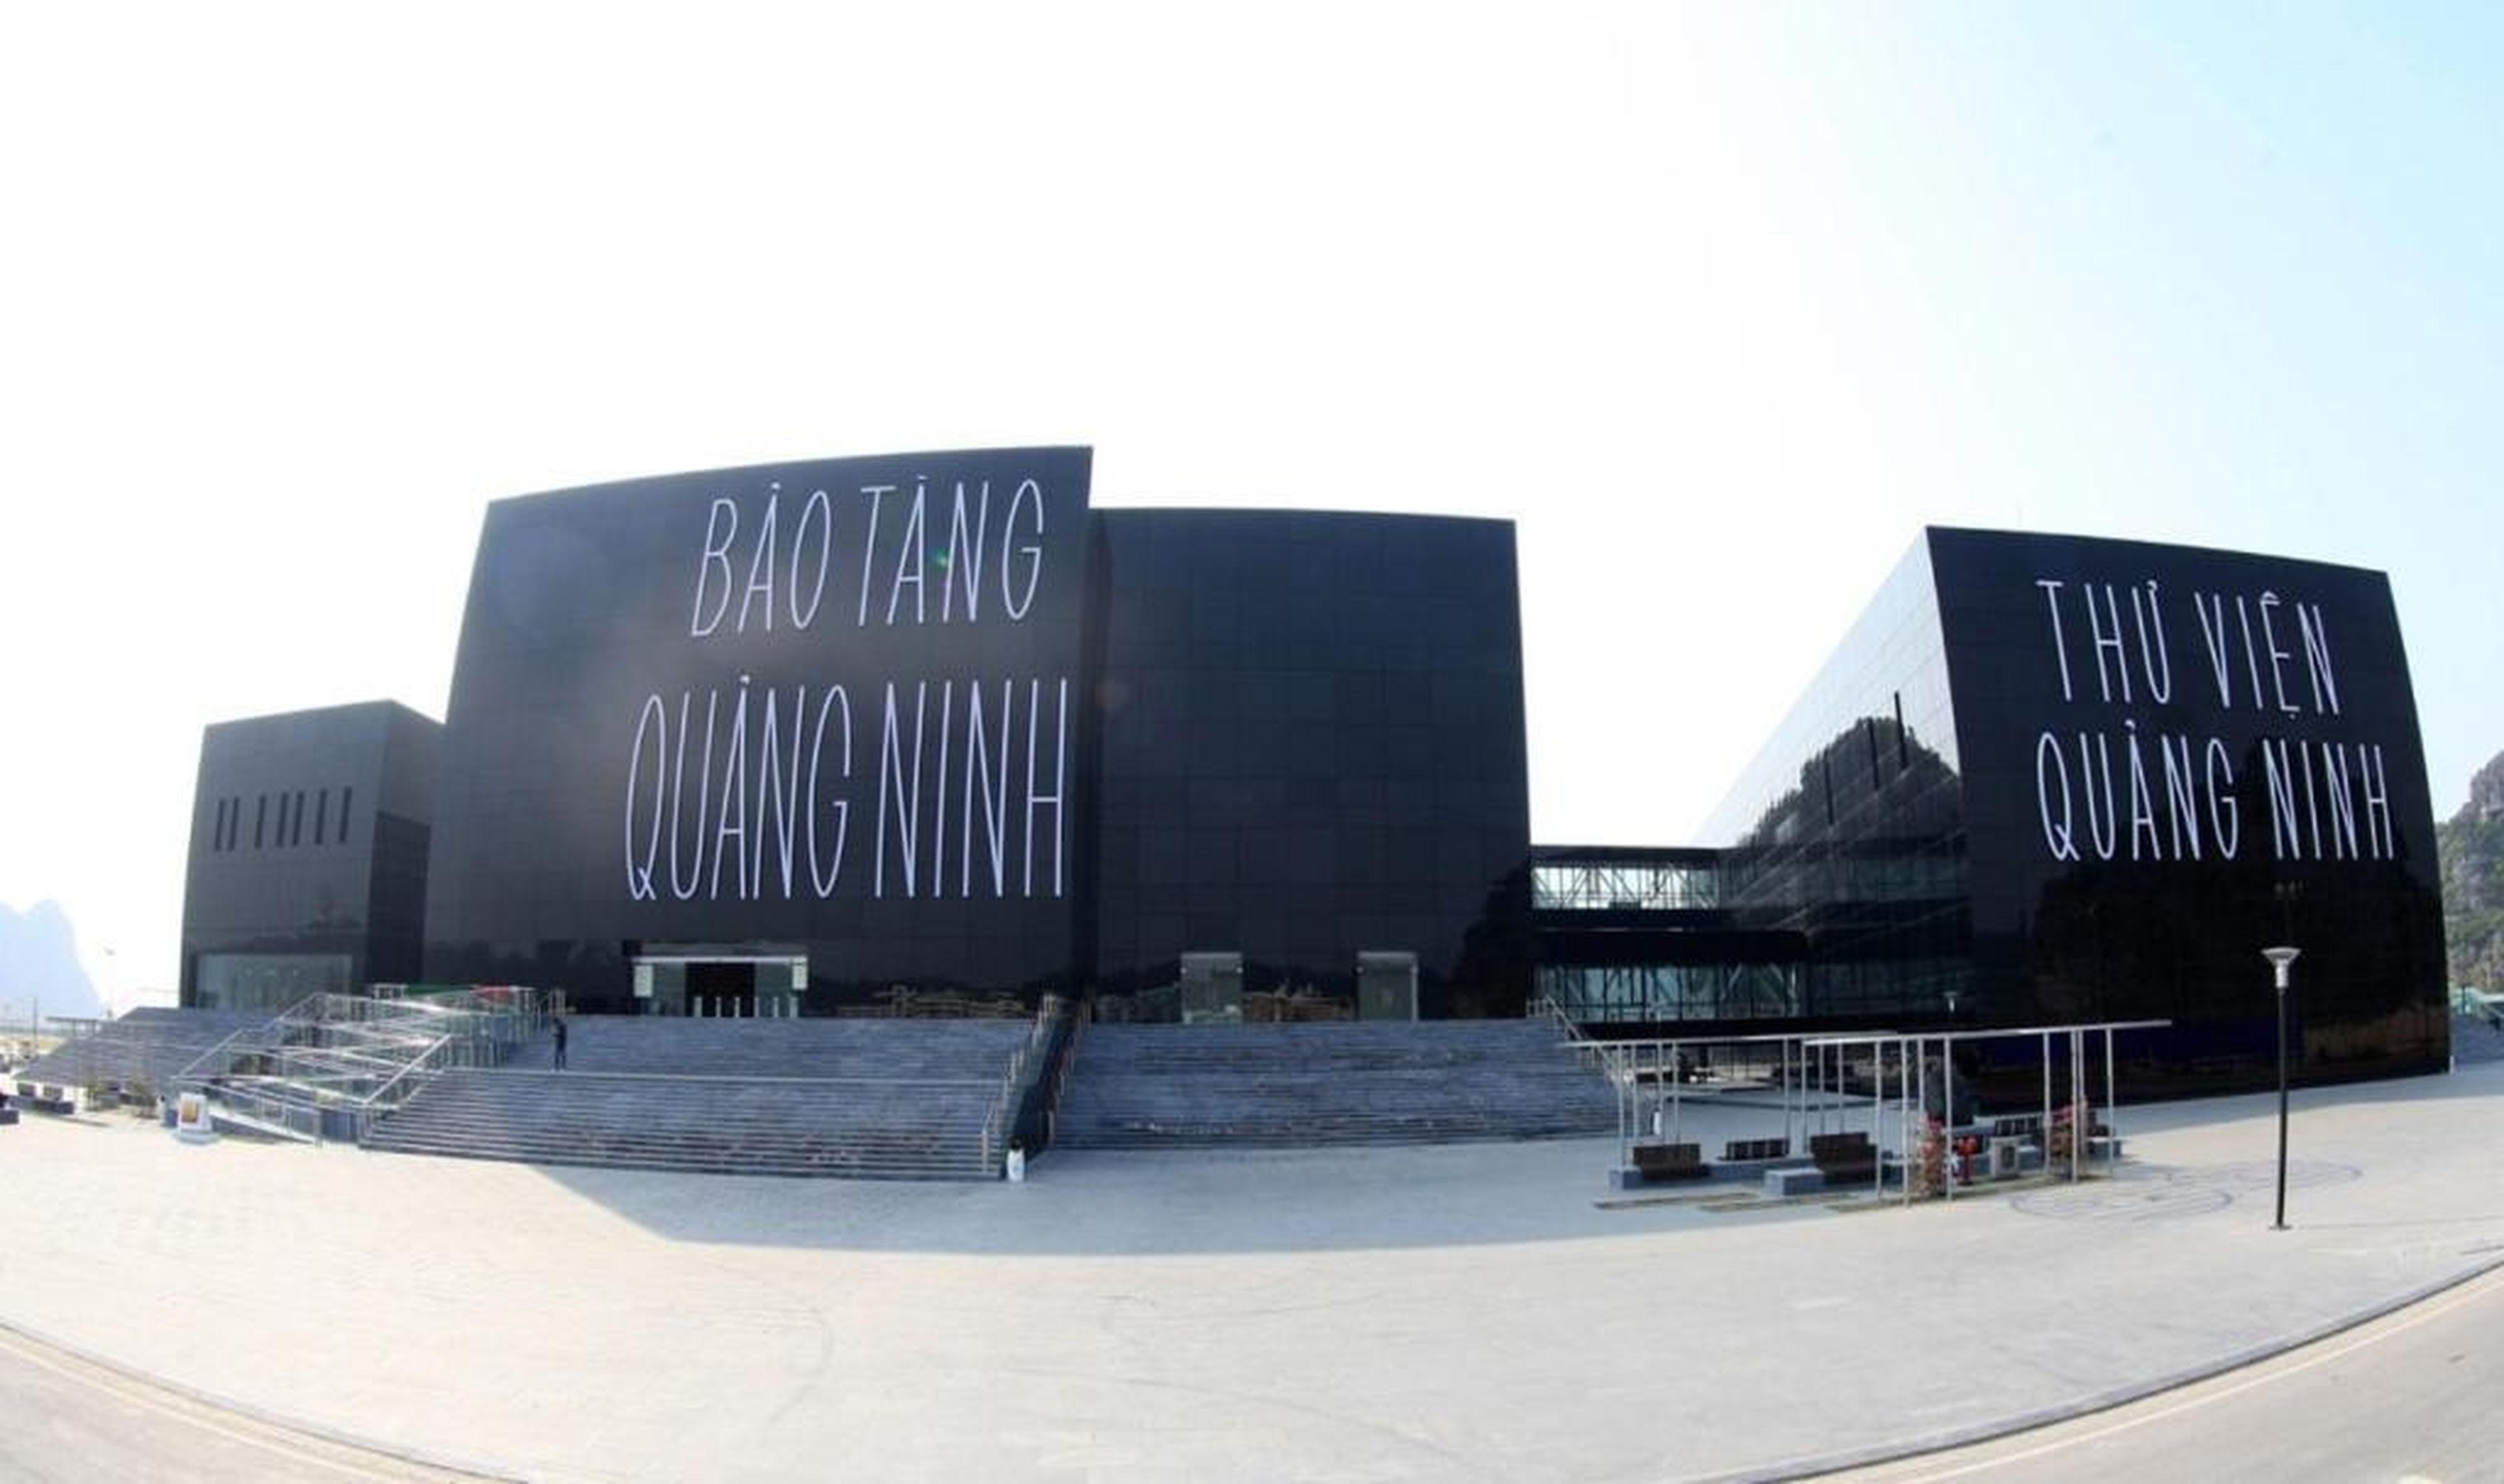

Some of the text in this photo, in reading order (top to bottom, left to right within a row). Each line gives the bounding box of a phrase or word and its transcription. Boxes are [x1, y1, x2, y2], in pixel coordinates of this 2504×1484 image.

[689, 481, 831, 638] BẢO
[2035, 580, 2340, 719] THƯ VIỆN
[625, 674, 1067, 900] QUẢNG NINH
[2036, 719, 2394, 862] QUẢNG NINH
